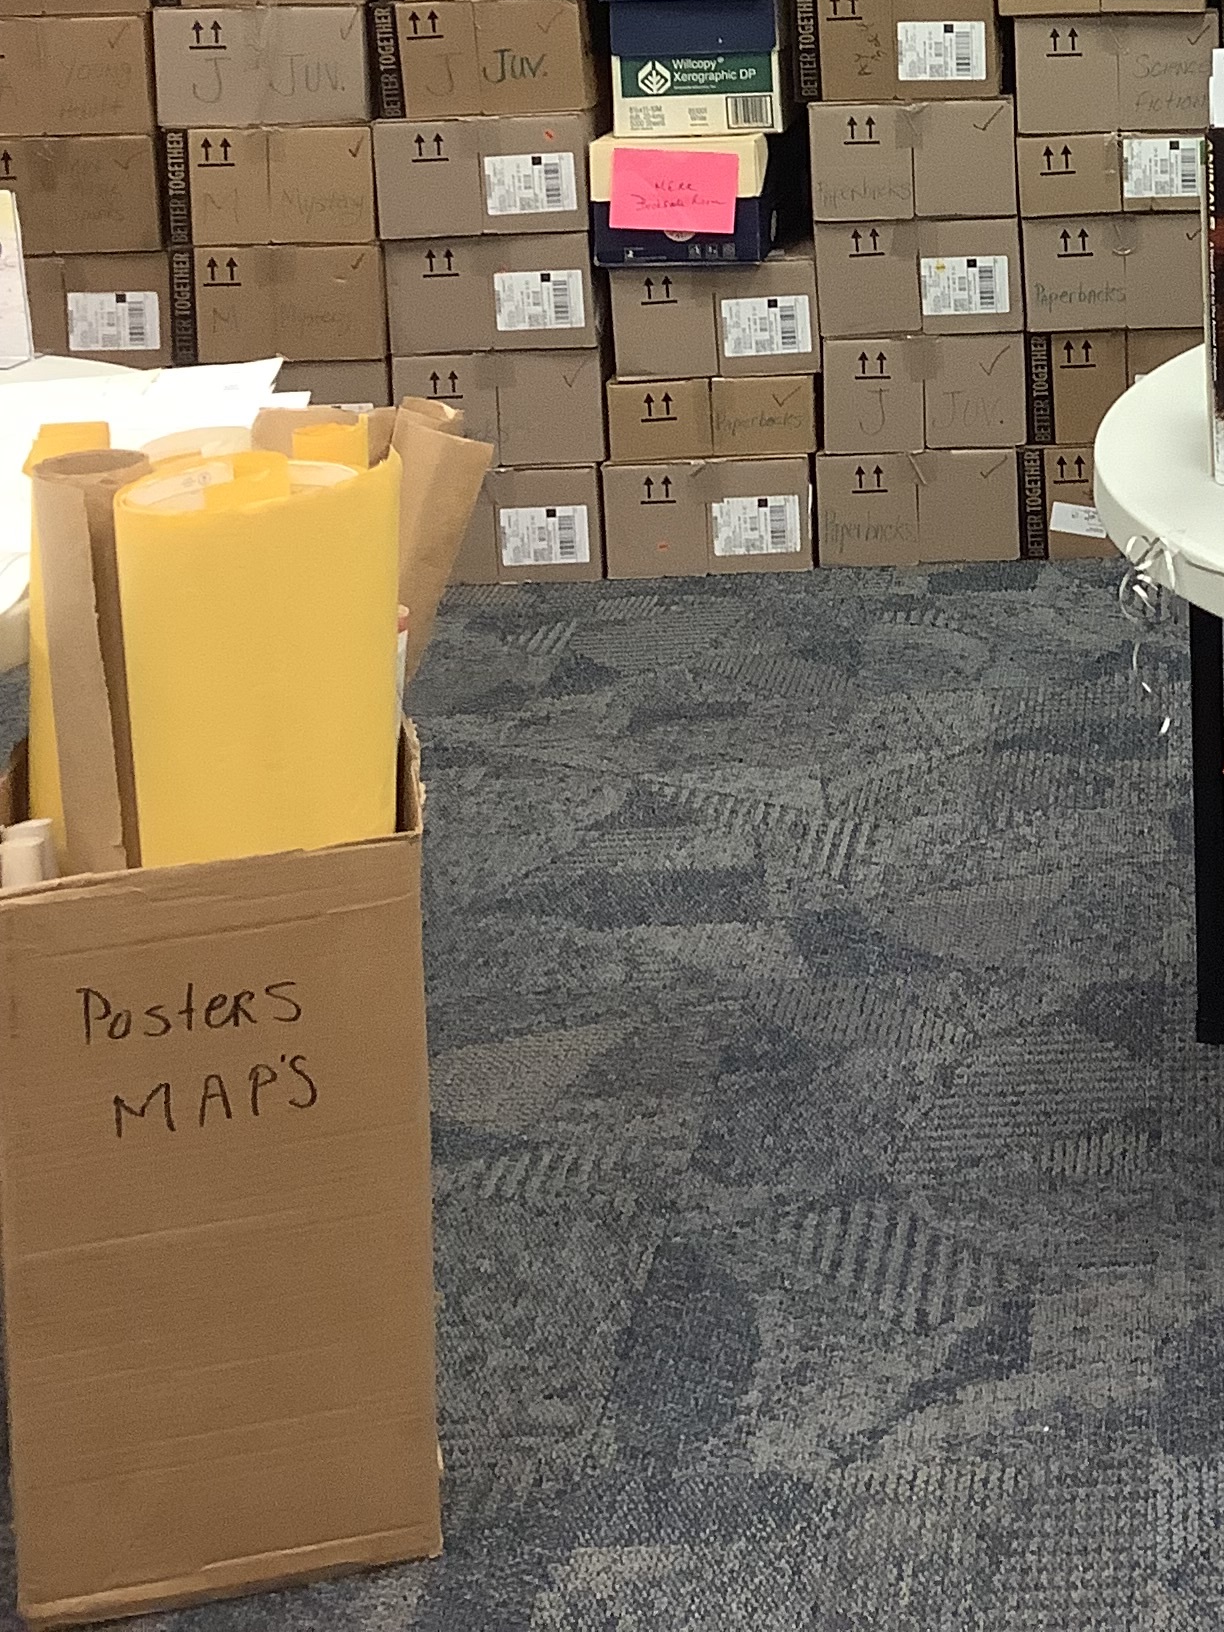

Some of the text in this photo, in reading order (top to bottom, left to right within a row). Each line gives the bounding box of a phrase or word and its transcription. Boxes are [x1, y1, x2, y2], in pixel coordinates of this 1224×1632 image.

[376, 7, 396, 68] TOGETHER
[482, 48, 549, 78] Juv.
[673, 69, 756, 84] Xerographic DP
[167, 132, 184, 195] TOGETHER
[173, 252, 193, 314] TOGETHER
[1033, 337, 1047, 395] TOGETHER
[1026, 452, 1040, 513] TOGETHER
